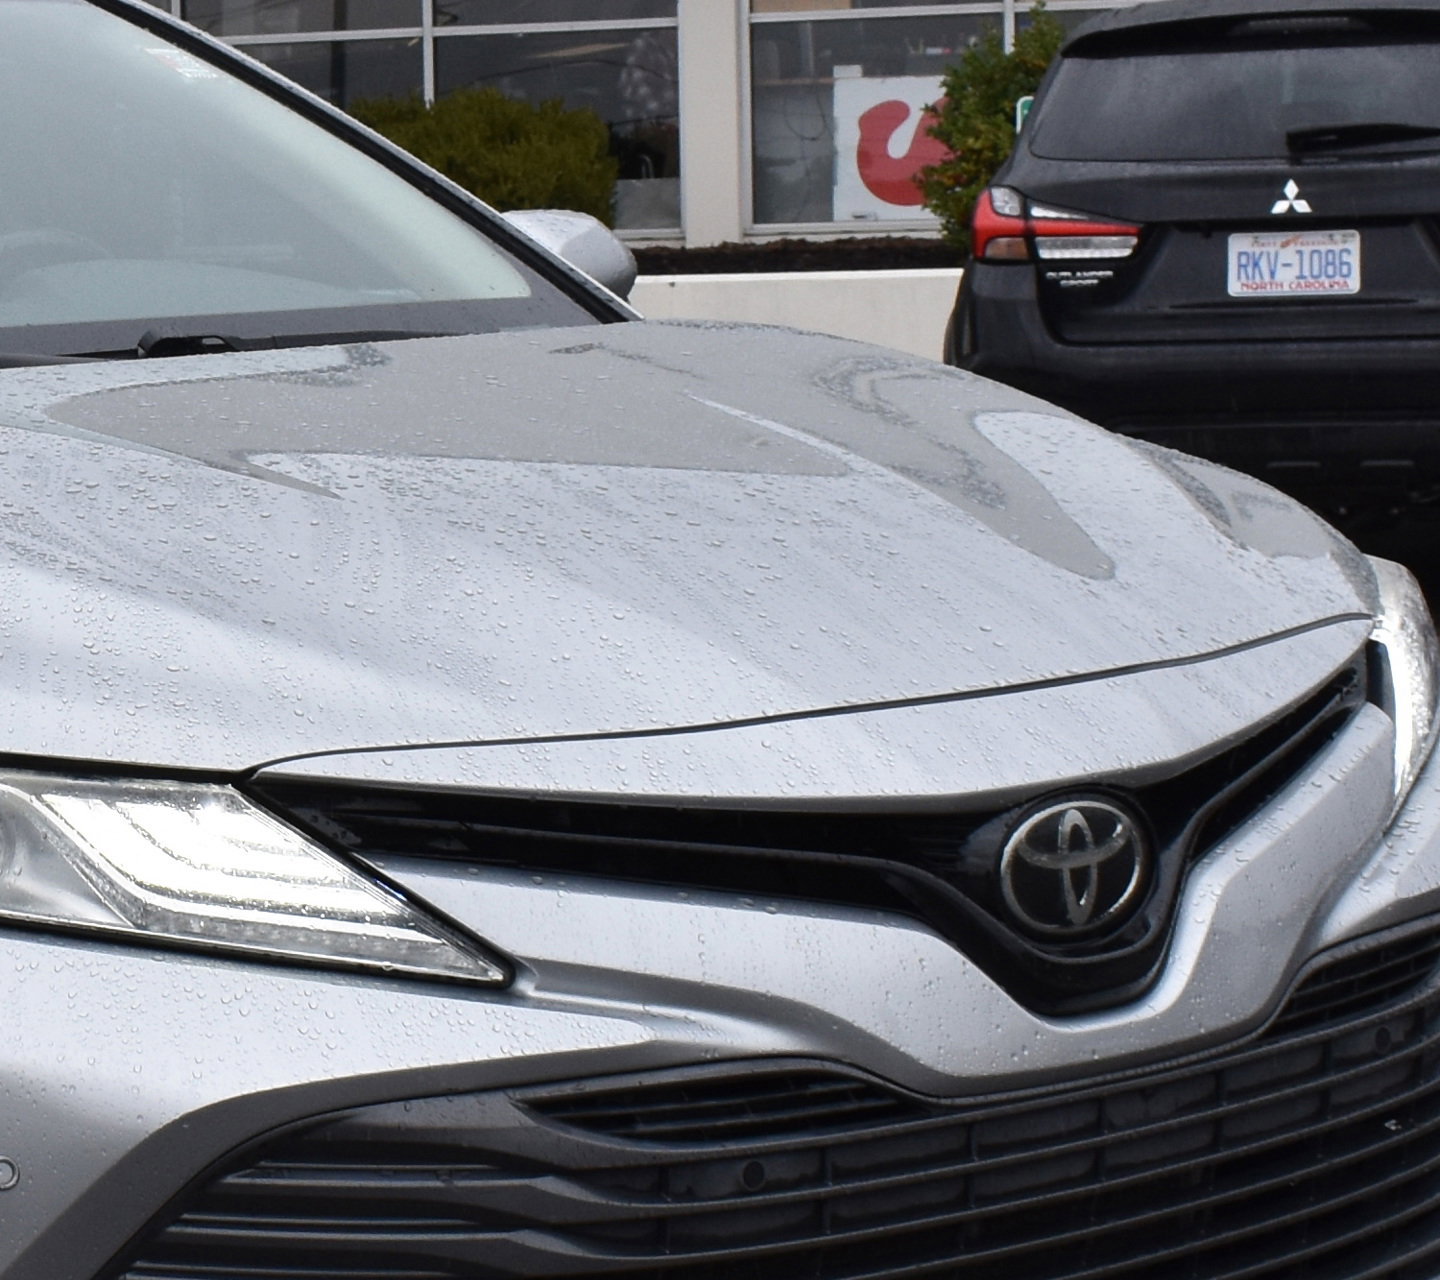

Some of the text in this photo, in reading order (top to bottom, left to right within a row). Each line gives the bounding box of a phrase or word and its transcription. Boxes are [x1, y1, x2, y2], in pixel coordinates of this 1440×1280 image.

[1236, 248, 1352, 281] RKV-1086
[1240, 279, 1349, 291] NORTH CAROLINA
